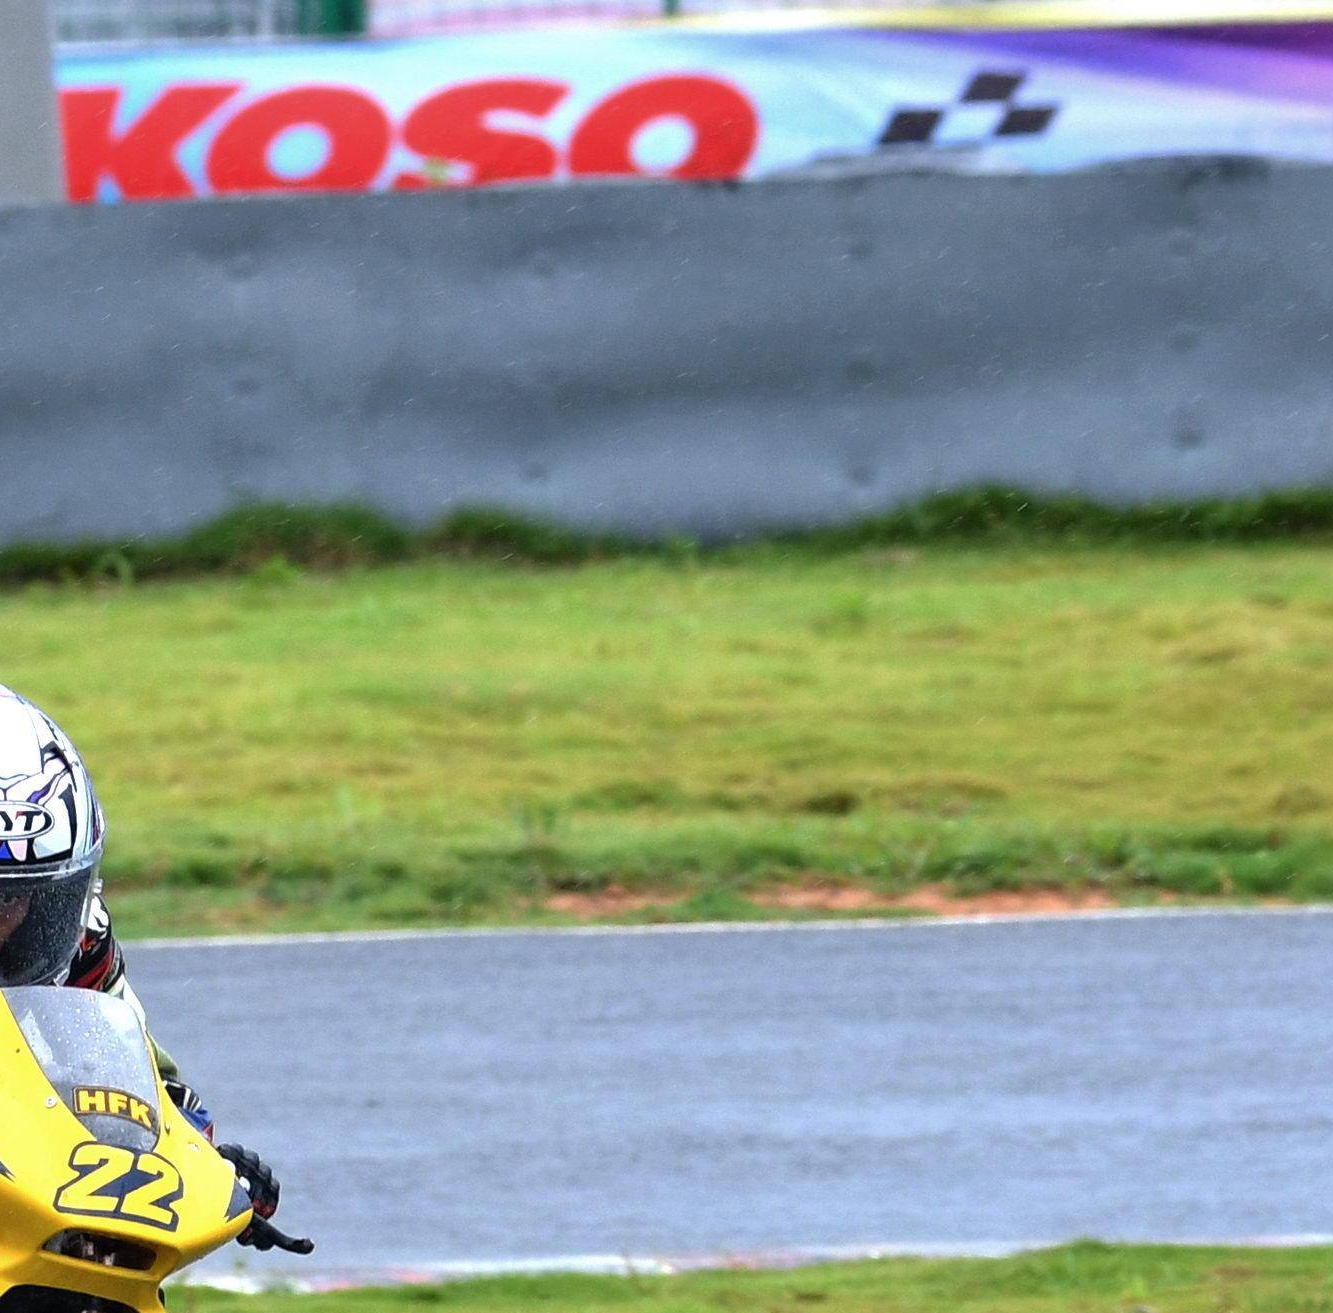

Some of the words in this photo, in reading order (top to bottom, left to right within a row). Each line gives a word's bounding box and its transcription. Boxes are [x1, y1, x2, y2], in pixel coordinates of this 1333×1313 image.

[59, 72, 759, 201] KOSO
[78, 1089, 153, 1129] HFK
[54, 1141, 184, 1232] 22
